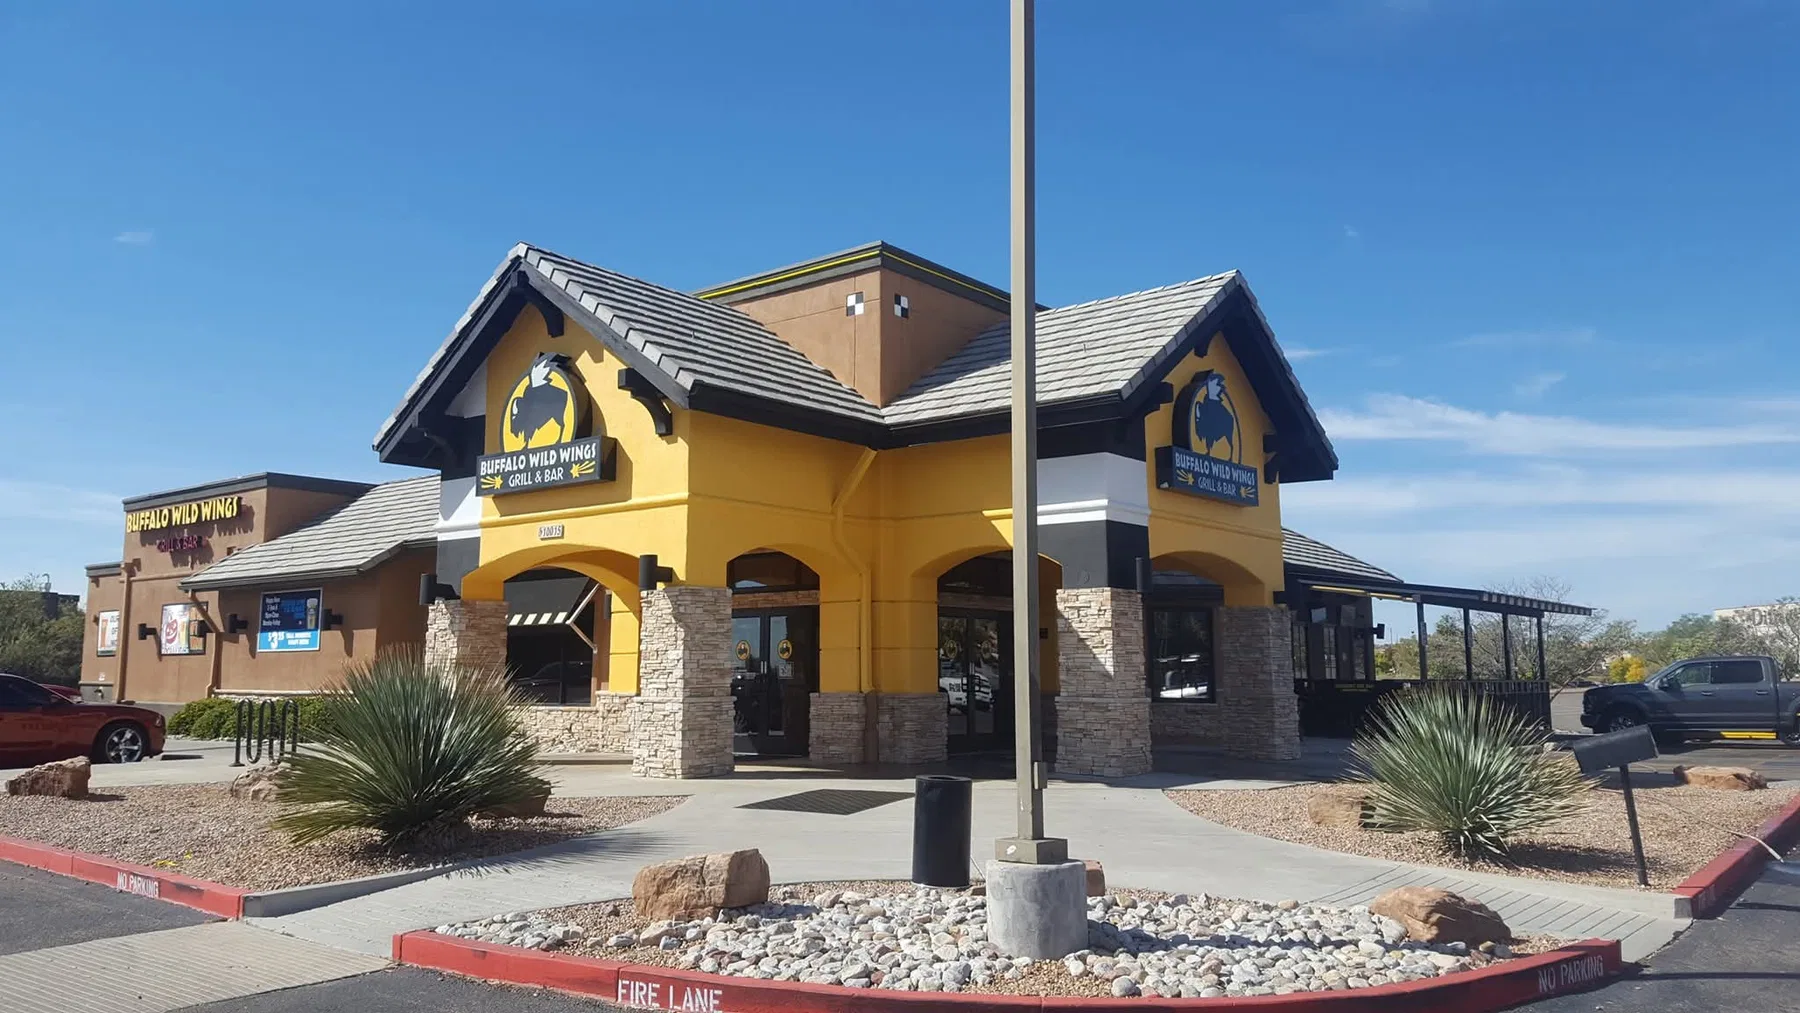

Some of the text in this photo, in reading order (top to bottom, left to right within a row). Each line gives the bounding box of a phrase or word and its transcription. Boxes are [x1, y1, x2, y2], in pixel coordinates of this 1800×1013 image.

[480, 442, 597, 476] BUFFALO WILD WINGS
[1175, 452, 1255, 486] BUFFALO WILD WINGS
[508, 467, 564, 488] GRILL & BAR
[1197, 476, 1237, 497] GRILL & BAR
[126, 496, 238, 533] BUFFALO WILD WINGS
[183, 535, 198, 550] BAR
[117, 872, 159, 898] NO PARKING
[1538, 955, 1604, 993] NO PARKING
[617, 979, 723, 1013] FIRE LANE
